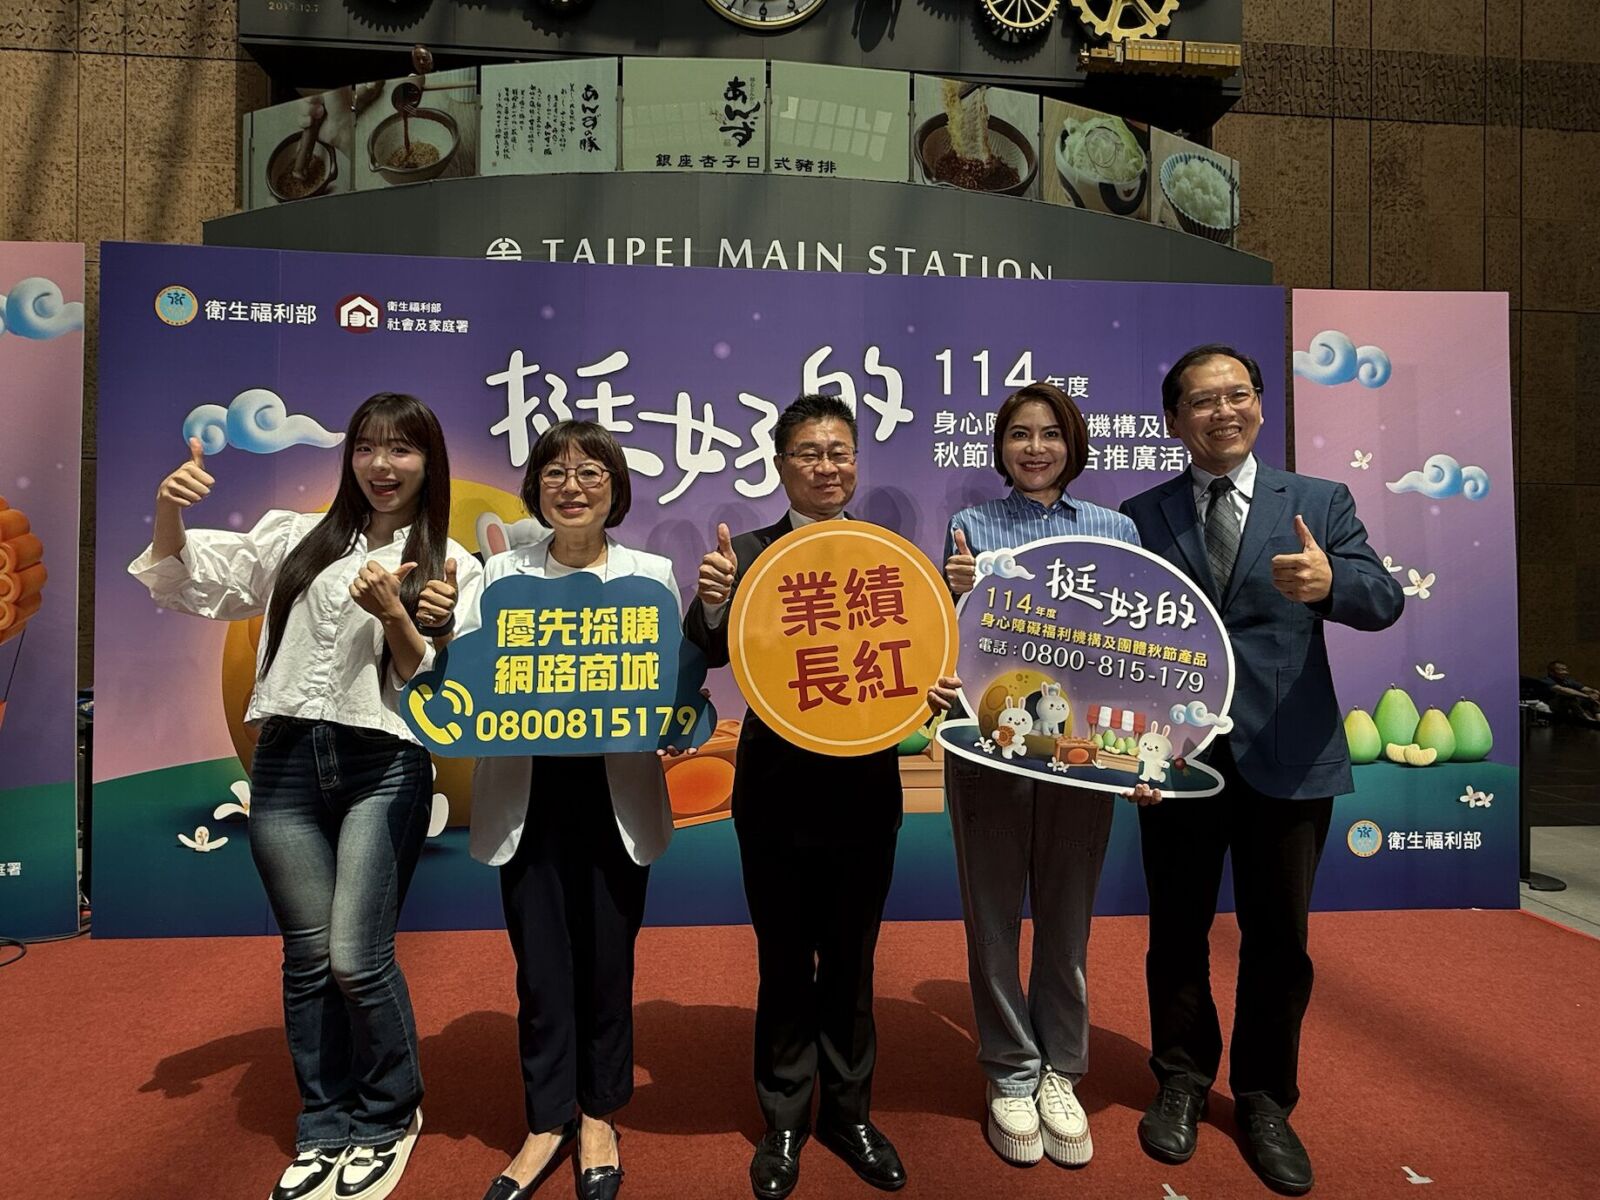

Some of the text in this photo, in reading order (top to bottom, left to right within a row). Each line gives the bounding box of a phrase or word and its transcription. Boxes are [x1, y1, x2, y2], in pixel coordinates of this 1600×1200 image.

[759, 3, 768, 16] 6
[719, 76, 761, 148] あんず
[655, 153, 837, 174] 銀座杏子日式豬排
[542, 237, 1053, 280] TAIPEI MAIN STATION
[204, 300, 317, 325] 衛生福利部
[387, 301, 442, 313] 衛生福利部
[387, 317, 469, 333] 社會及家庭署
[778, 565, 908, 636] 業績
[986, 587, 1057, 620] 114年度
[1045, 558, 1197, 630] 挺好的
[496, 607, 659, 648] 優先採購
[980, 612, 1208, 667] 身心障礙福利機構及團體秋節產品
[494, 652, 660, 694] 網路商城
[788, 639, 919, 712] 長紅
[476, 706, 697, 741] 0800815179
[1387, 831, 1482, 850] 衛生福利部
